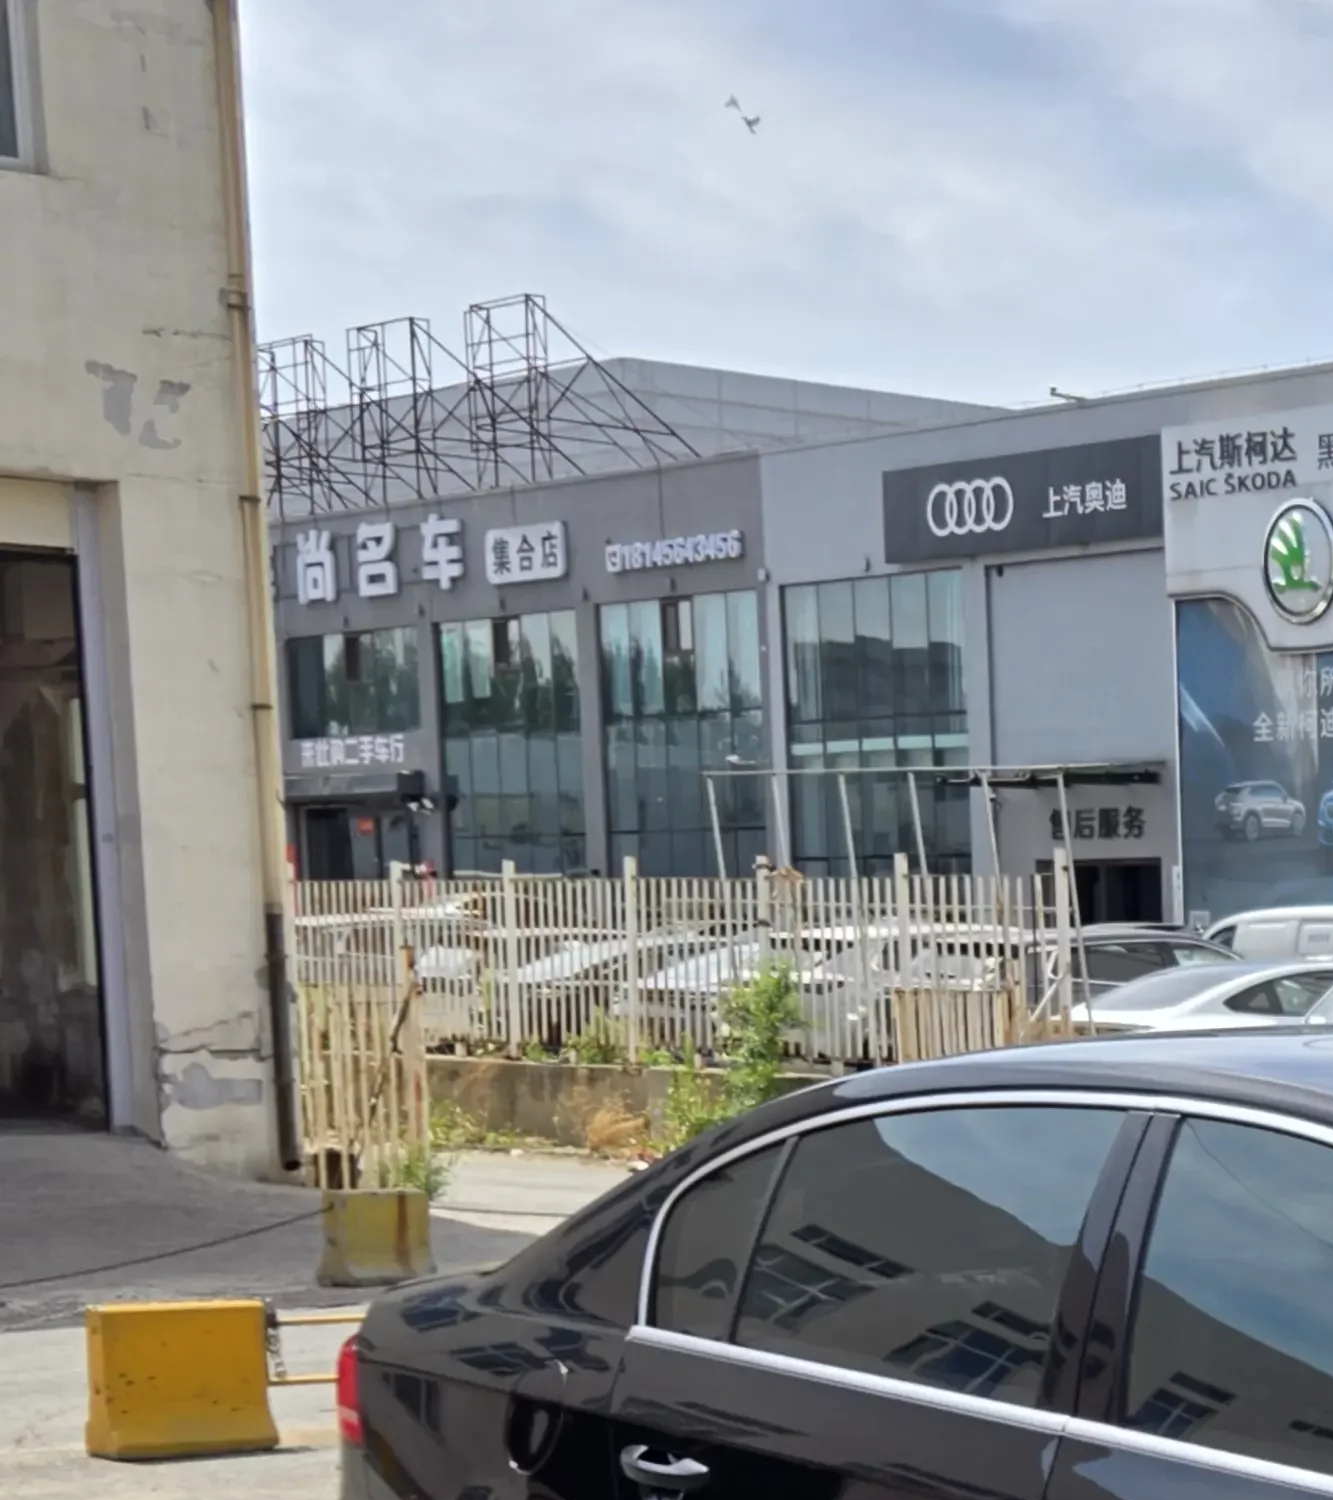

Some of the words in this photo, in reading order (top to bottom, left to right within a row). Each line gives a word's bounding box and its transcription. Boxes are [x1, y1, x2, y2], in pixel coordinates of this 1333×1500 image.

[1168, 426, 1298, 476] 上汽斯柯达
[1042, 477, 1128, 518] 上汽奥迪
[1169, 476, 1219, 501] SAIC
[272, 513, 465, 605] 尚名车
[490, 529, 561, 577] 集合店
